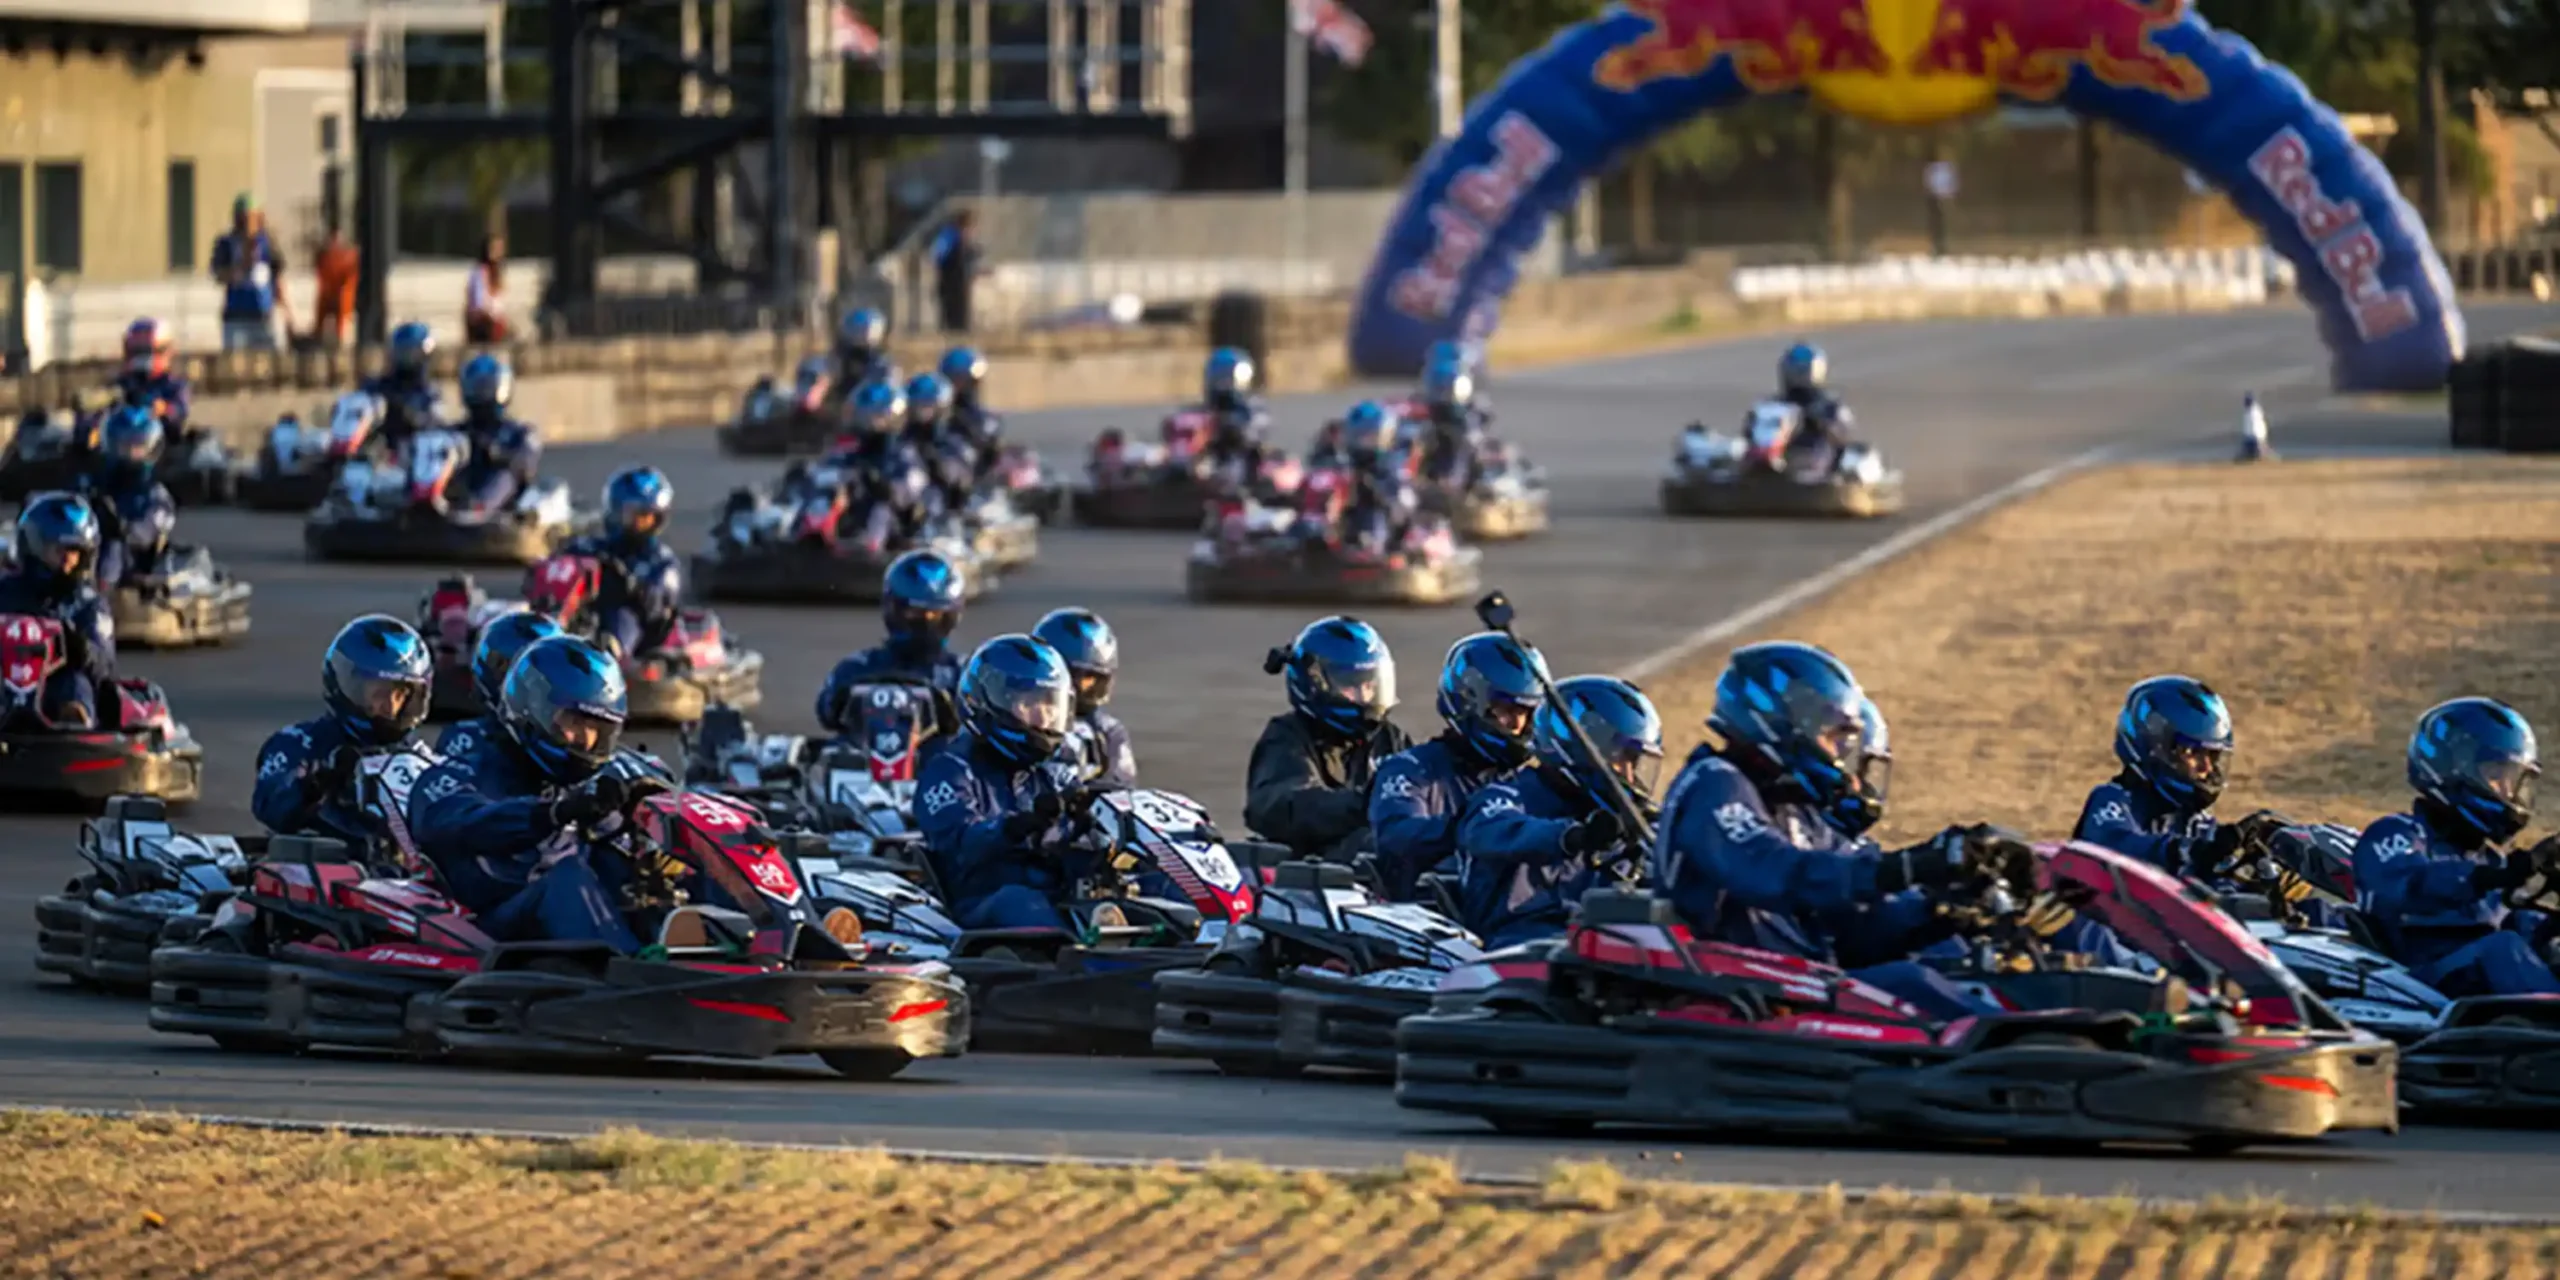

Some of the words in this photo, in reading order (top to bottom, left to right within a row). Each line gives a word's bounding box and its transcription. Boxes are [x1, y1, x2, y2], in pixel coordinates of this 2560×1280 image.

[2249, 125, 2361, 244] Red
[2320, 224, 2419, 341] Bull
[1142, 801, 1192, 823] 32
